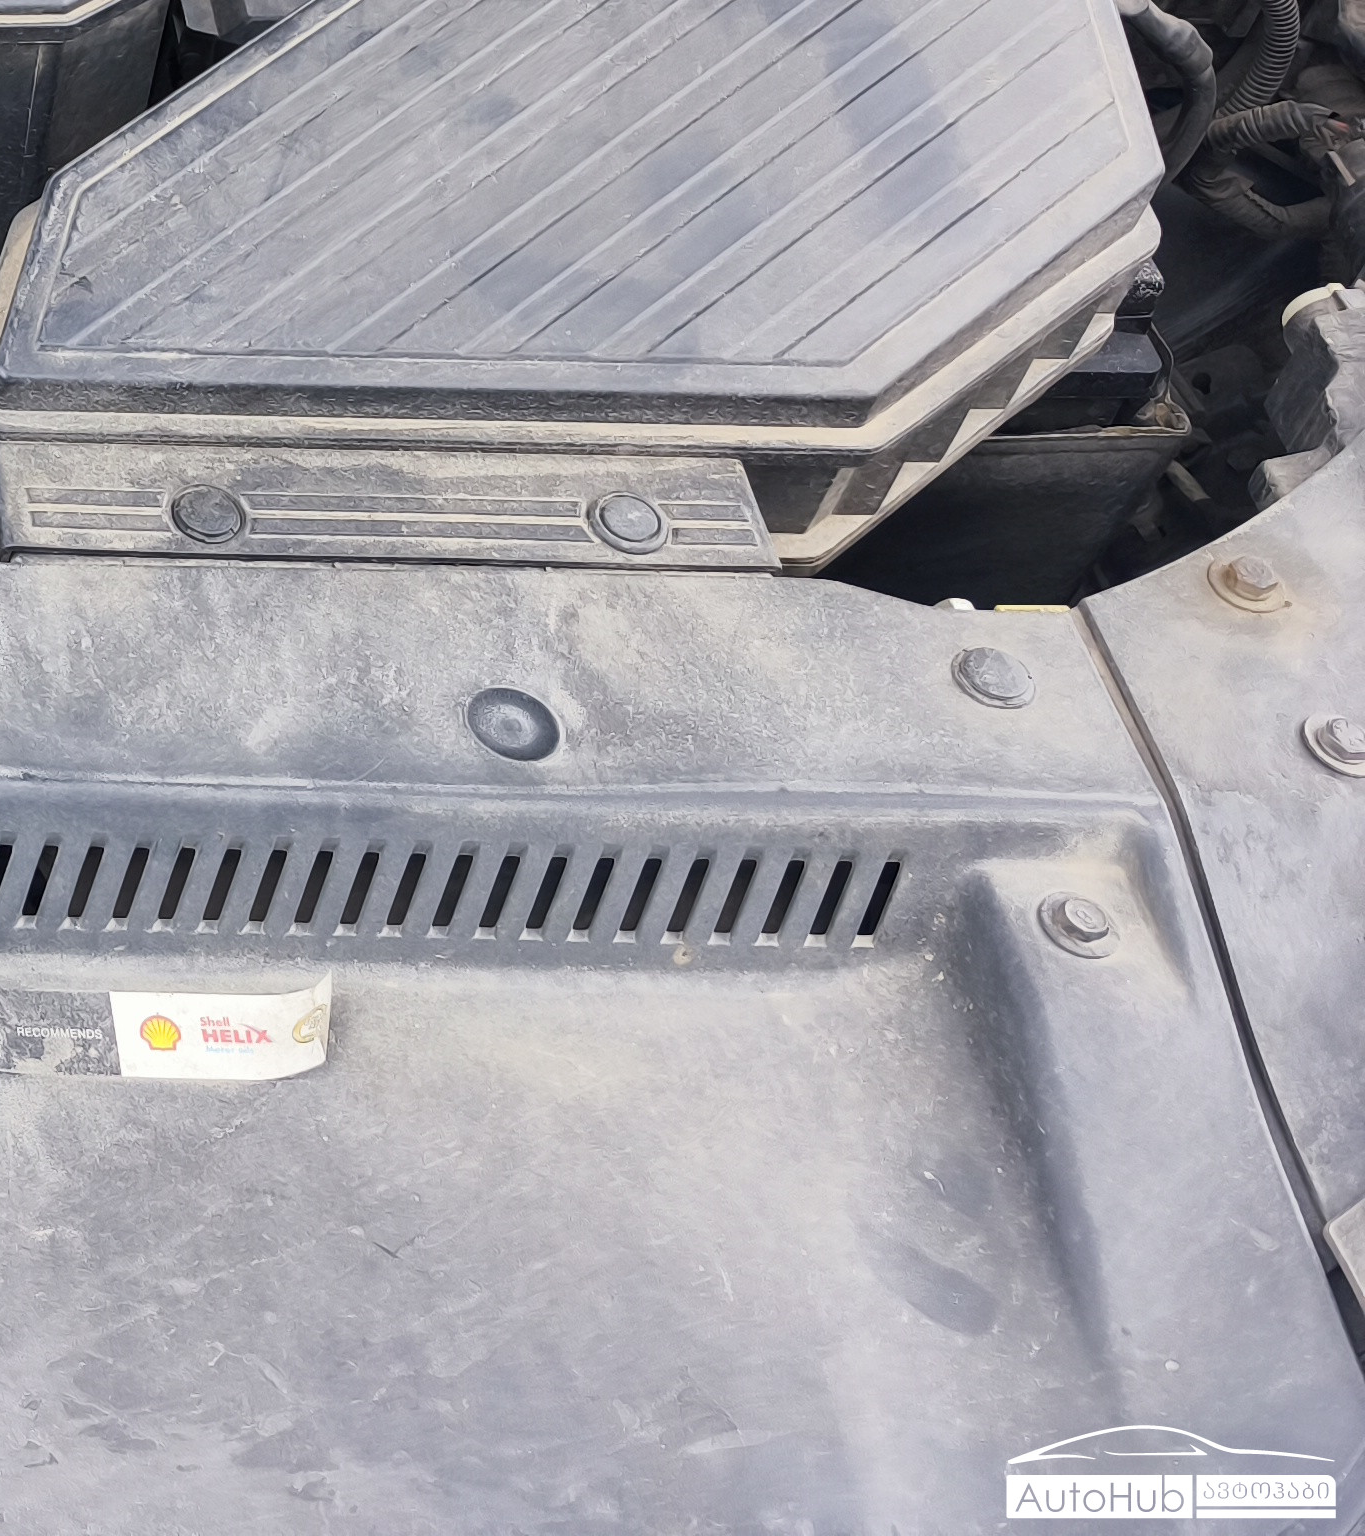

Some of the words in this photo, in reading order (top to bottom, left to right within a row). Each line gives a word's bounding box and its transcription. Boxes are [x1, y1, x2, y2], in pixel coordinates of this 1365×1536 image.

[199, 1016, 231, 1027] Shell
[16, 1026, 104, 1041] RECOMMENDS
[200, 1028, 274, 1044] HELIX
